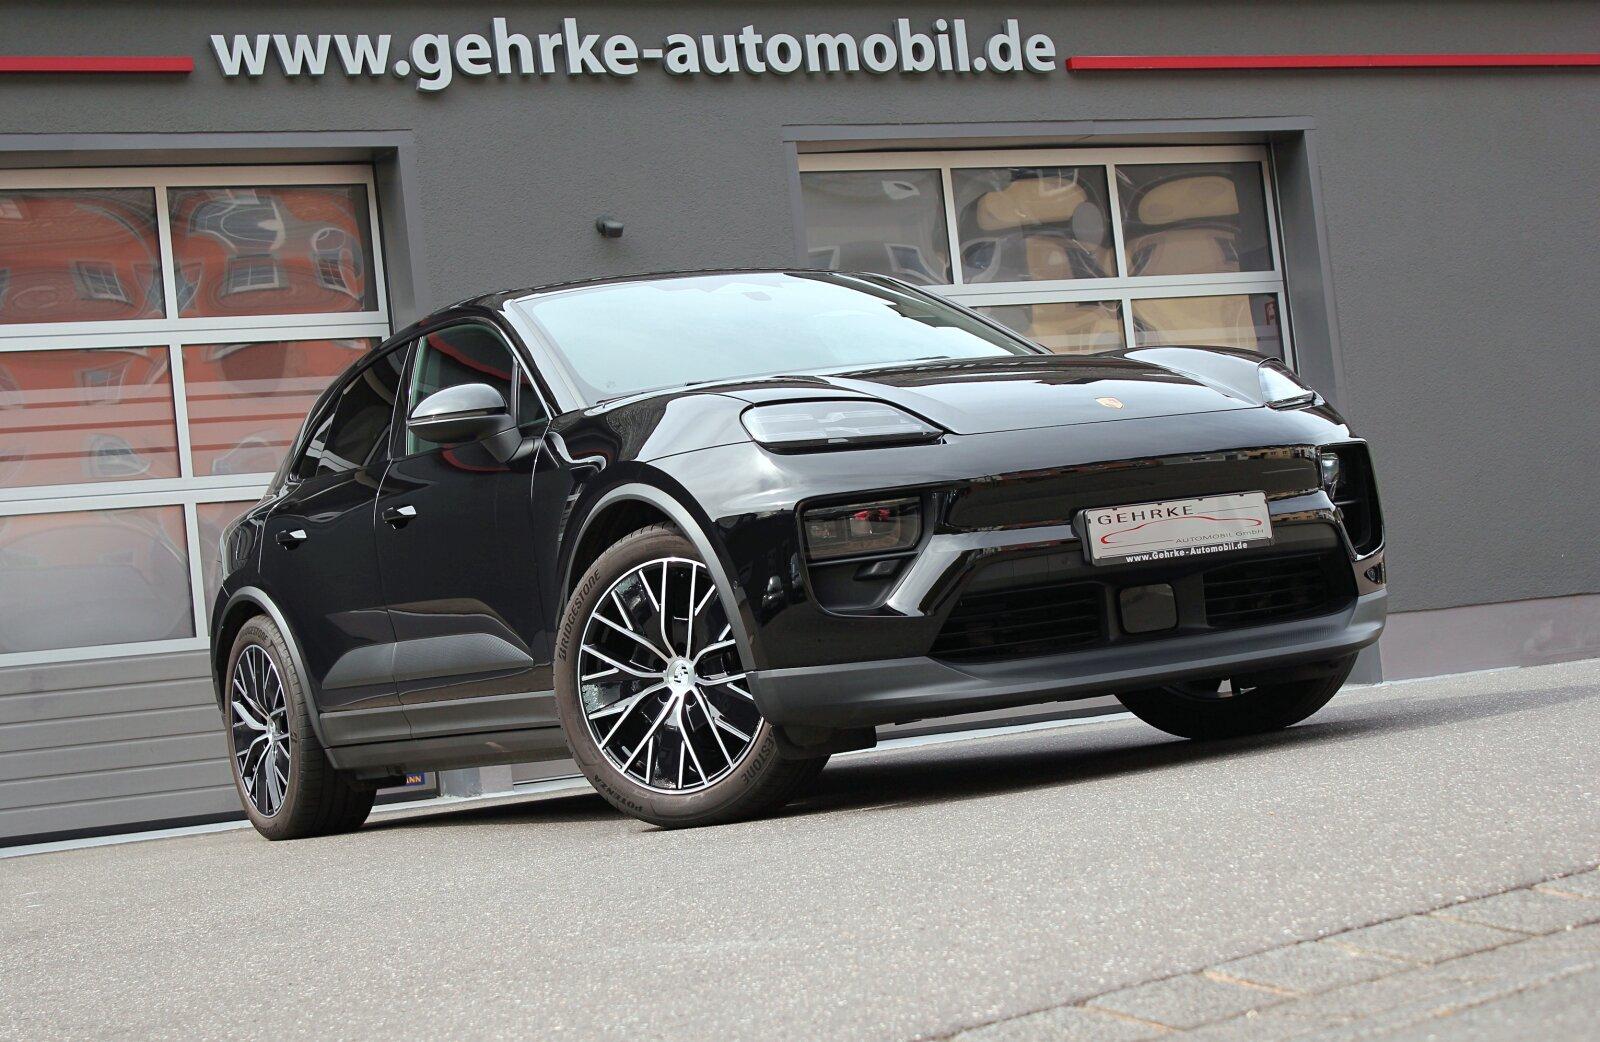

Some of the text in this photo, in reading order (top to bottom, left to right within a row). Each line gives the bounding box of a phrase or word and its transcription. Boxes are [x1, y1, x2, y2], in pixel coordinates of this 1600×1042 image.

[209, 17, 1057, 92] www.gehrke-automobil.de
[1098, 505, 1195, 525] GEHRKE
[1125, 541, 1248, 563] www.Gehrke-Automobil.de
[559, 569, 601, 662] BRIDGESTONE
